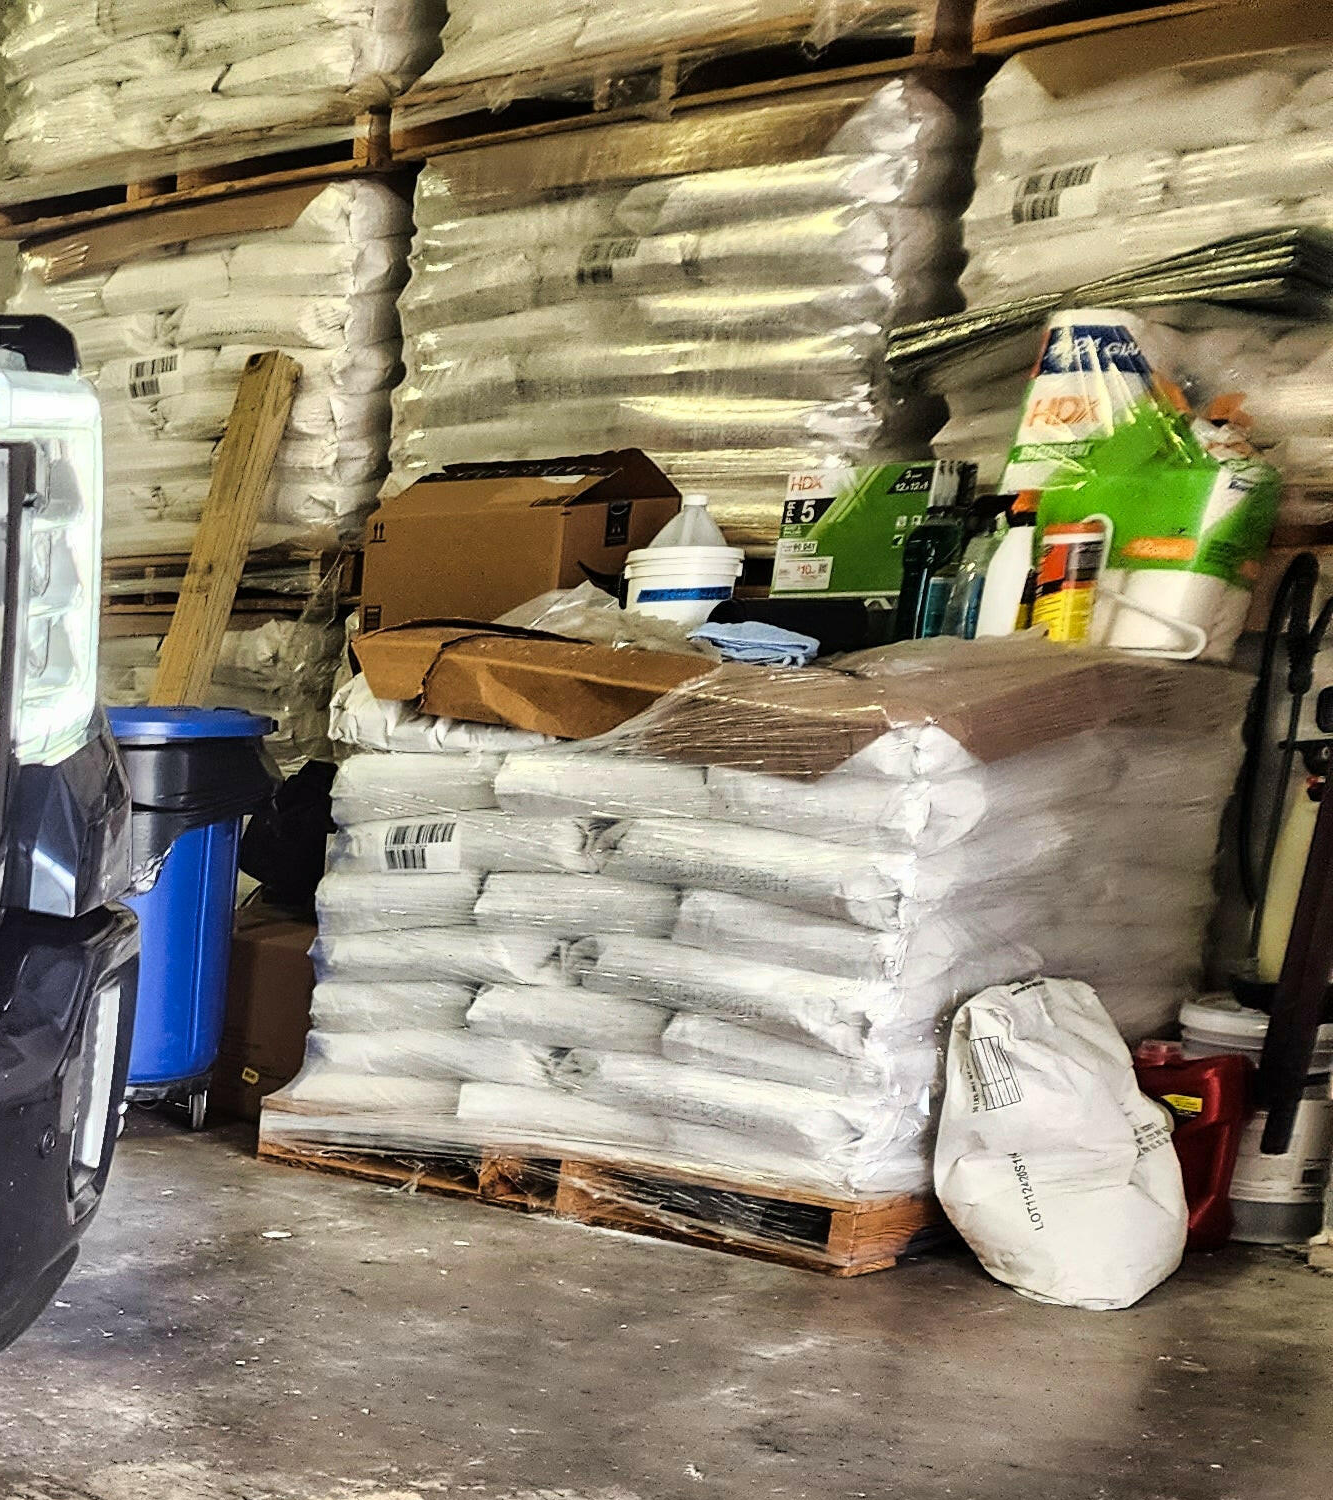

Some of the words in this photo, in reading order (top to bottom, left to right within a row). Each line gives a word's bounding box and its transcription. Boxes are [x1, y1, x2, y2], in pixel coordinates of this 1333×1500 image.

[1028, 396, 1100, 427] HDX
[790, 475, 823, 492] HDX
[785, 501, 797, 524] FPR
[800, 500, 816, 523] 5
